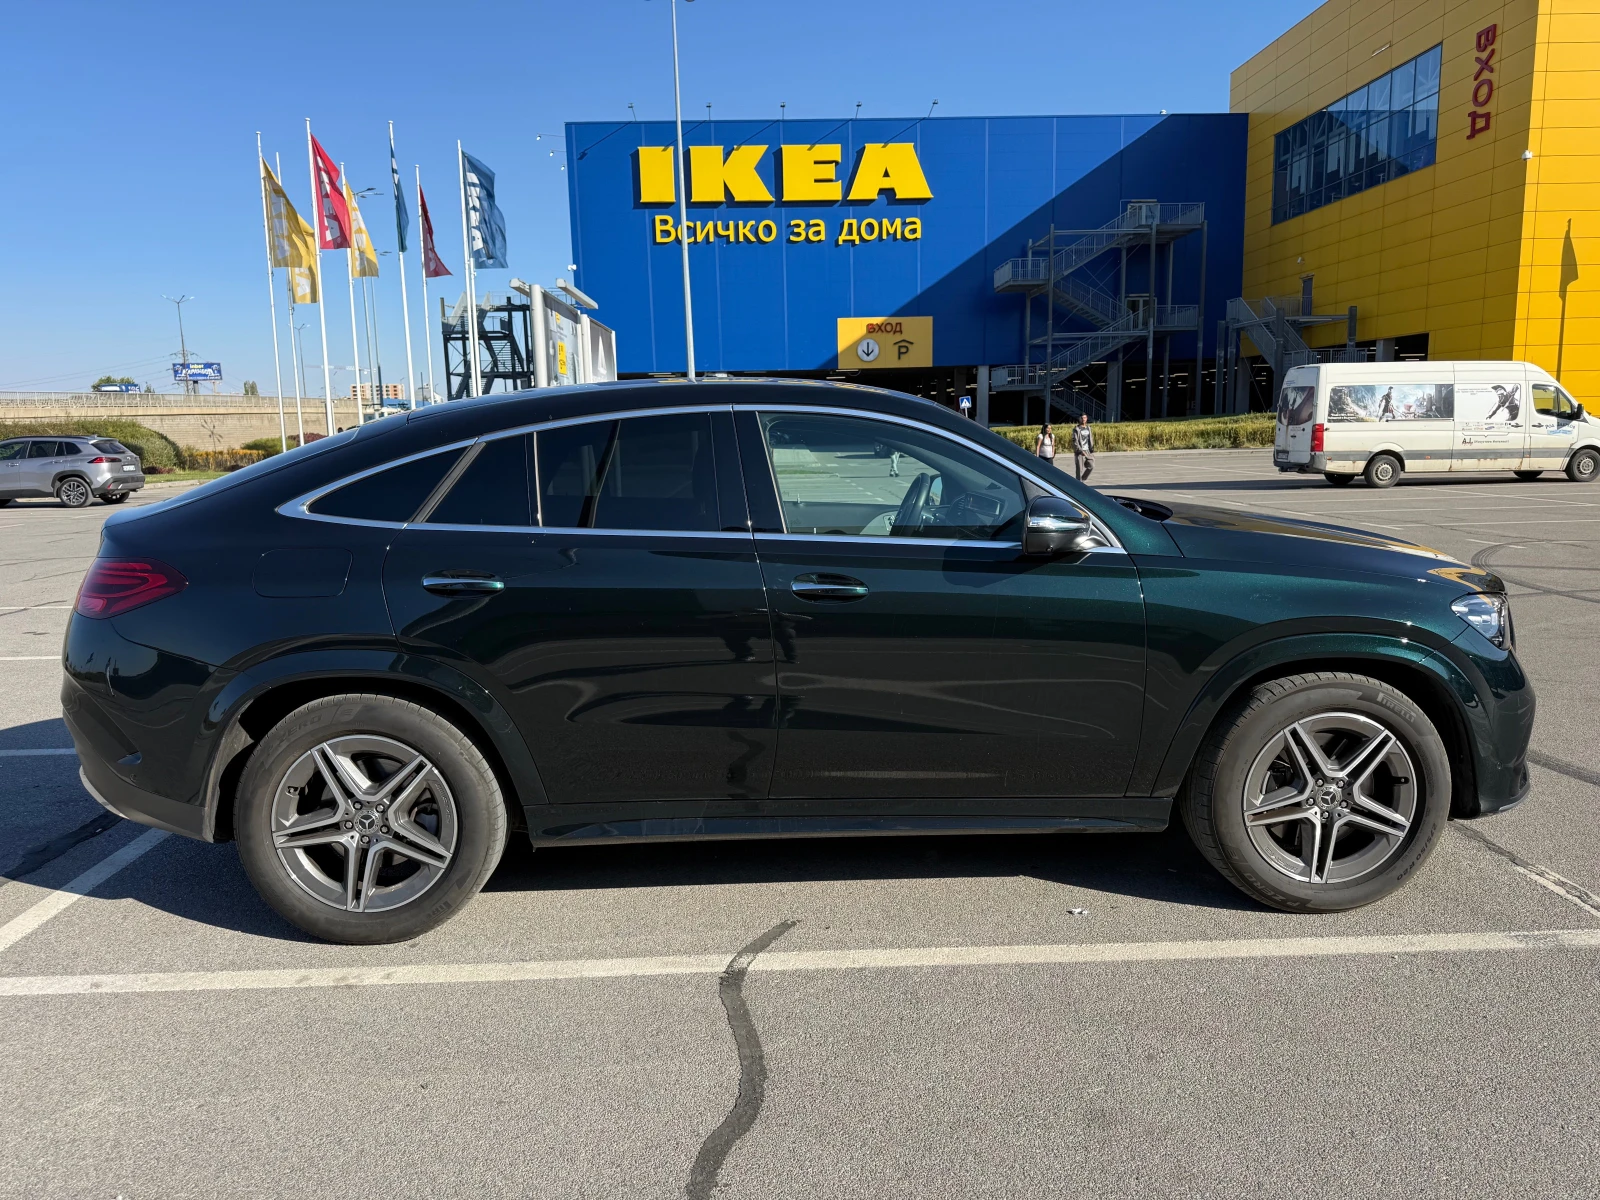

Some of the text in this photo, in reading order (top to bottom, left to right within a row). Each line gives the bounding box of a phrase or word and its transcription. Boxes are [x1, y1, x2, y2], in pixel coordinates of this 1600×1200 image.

[1466, 23, 1497, 140] ВХОД
[637, 143, 934, 203] IKEA
[466, 172, 484, 251] IKEA
[654, 215, 922, 245] Всичко за дома
[867, 322, 903, 335] ВХОД
[1376, 691, 1416, 723] PIRELLI
[1416, 822, 1437, 860] 275/50
[1244, 873, 1286, 901] ZERO
